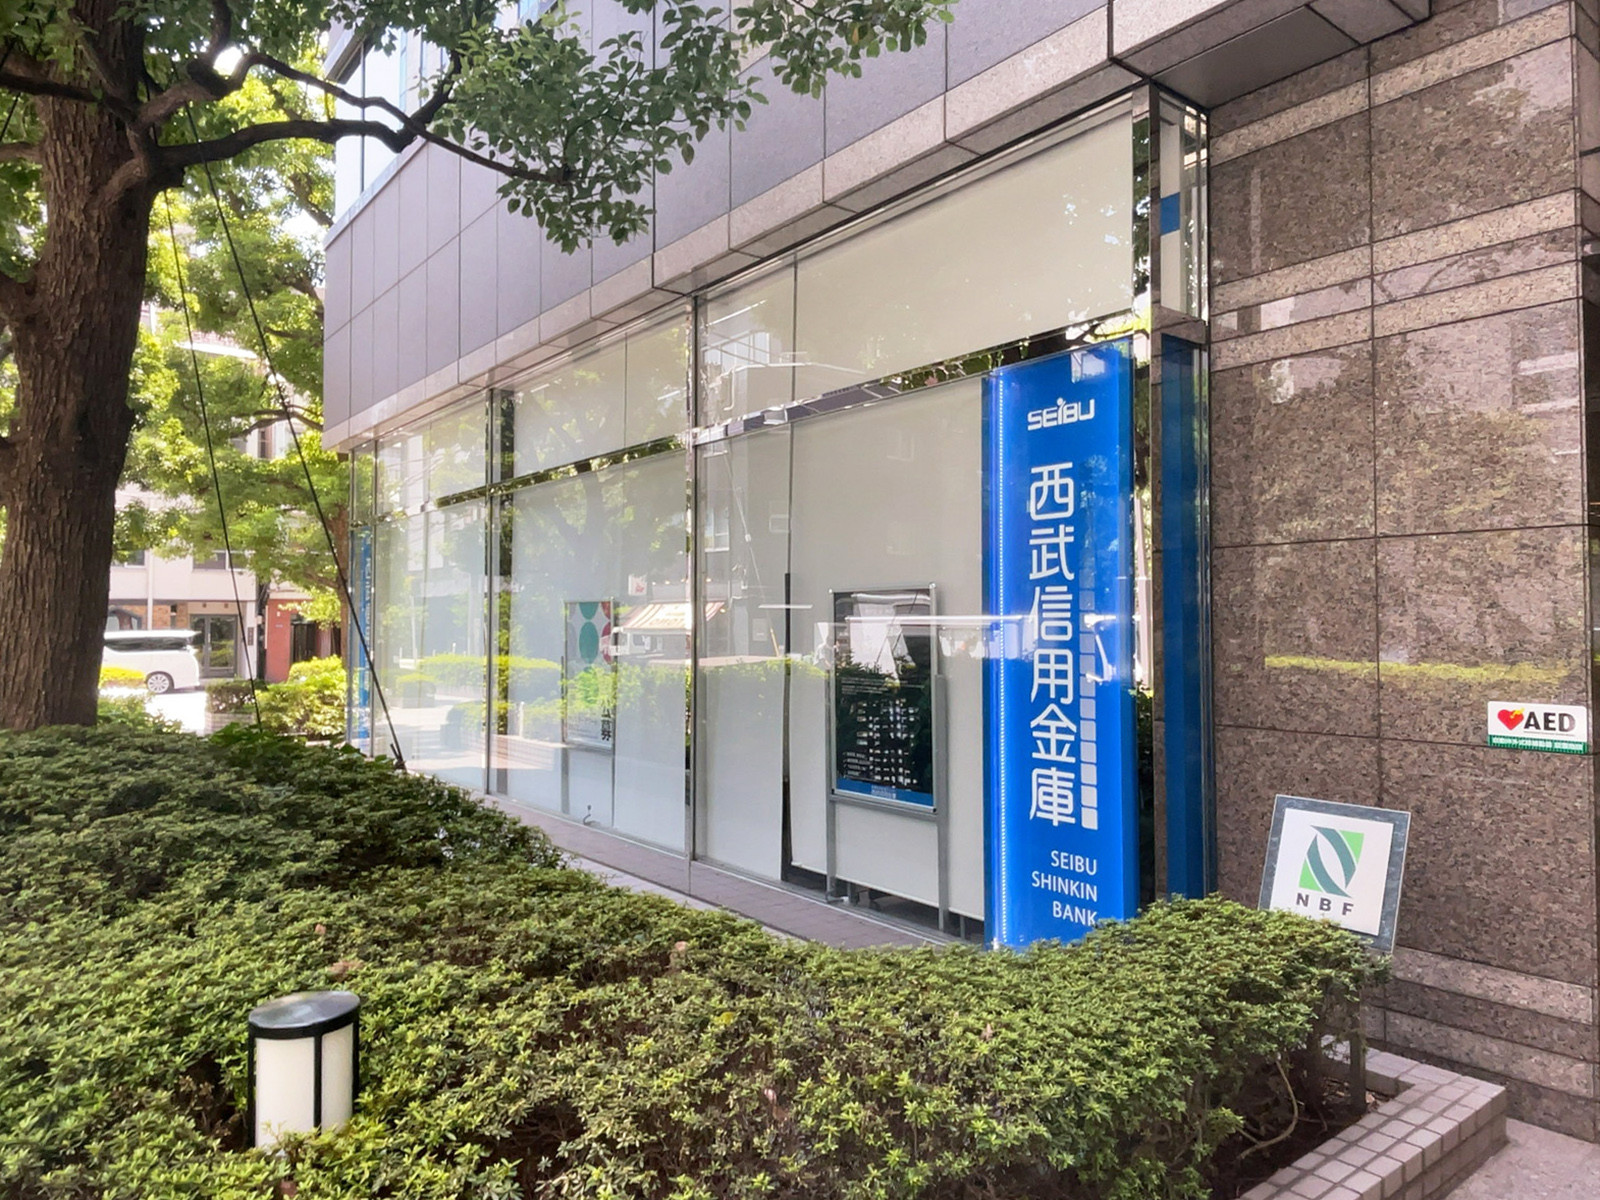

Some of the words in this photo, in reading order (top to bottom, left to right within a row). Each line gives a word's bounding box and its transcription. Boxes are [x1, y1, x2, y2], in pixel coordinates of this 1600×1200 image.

[1027, 397, 1095, 431] SEIBU
[1029, 462, 1077, 827] 西武信用金庫
[1523, 711, 1576, 733] AED
[1050, 850, 1098, 876] SEIBU
[1031, 870, 1098, 903] SHINKIN
[1052, 900, 1098, 926] BANK
